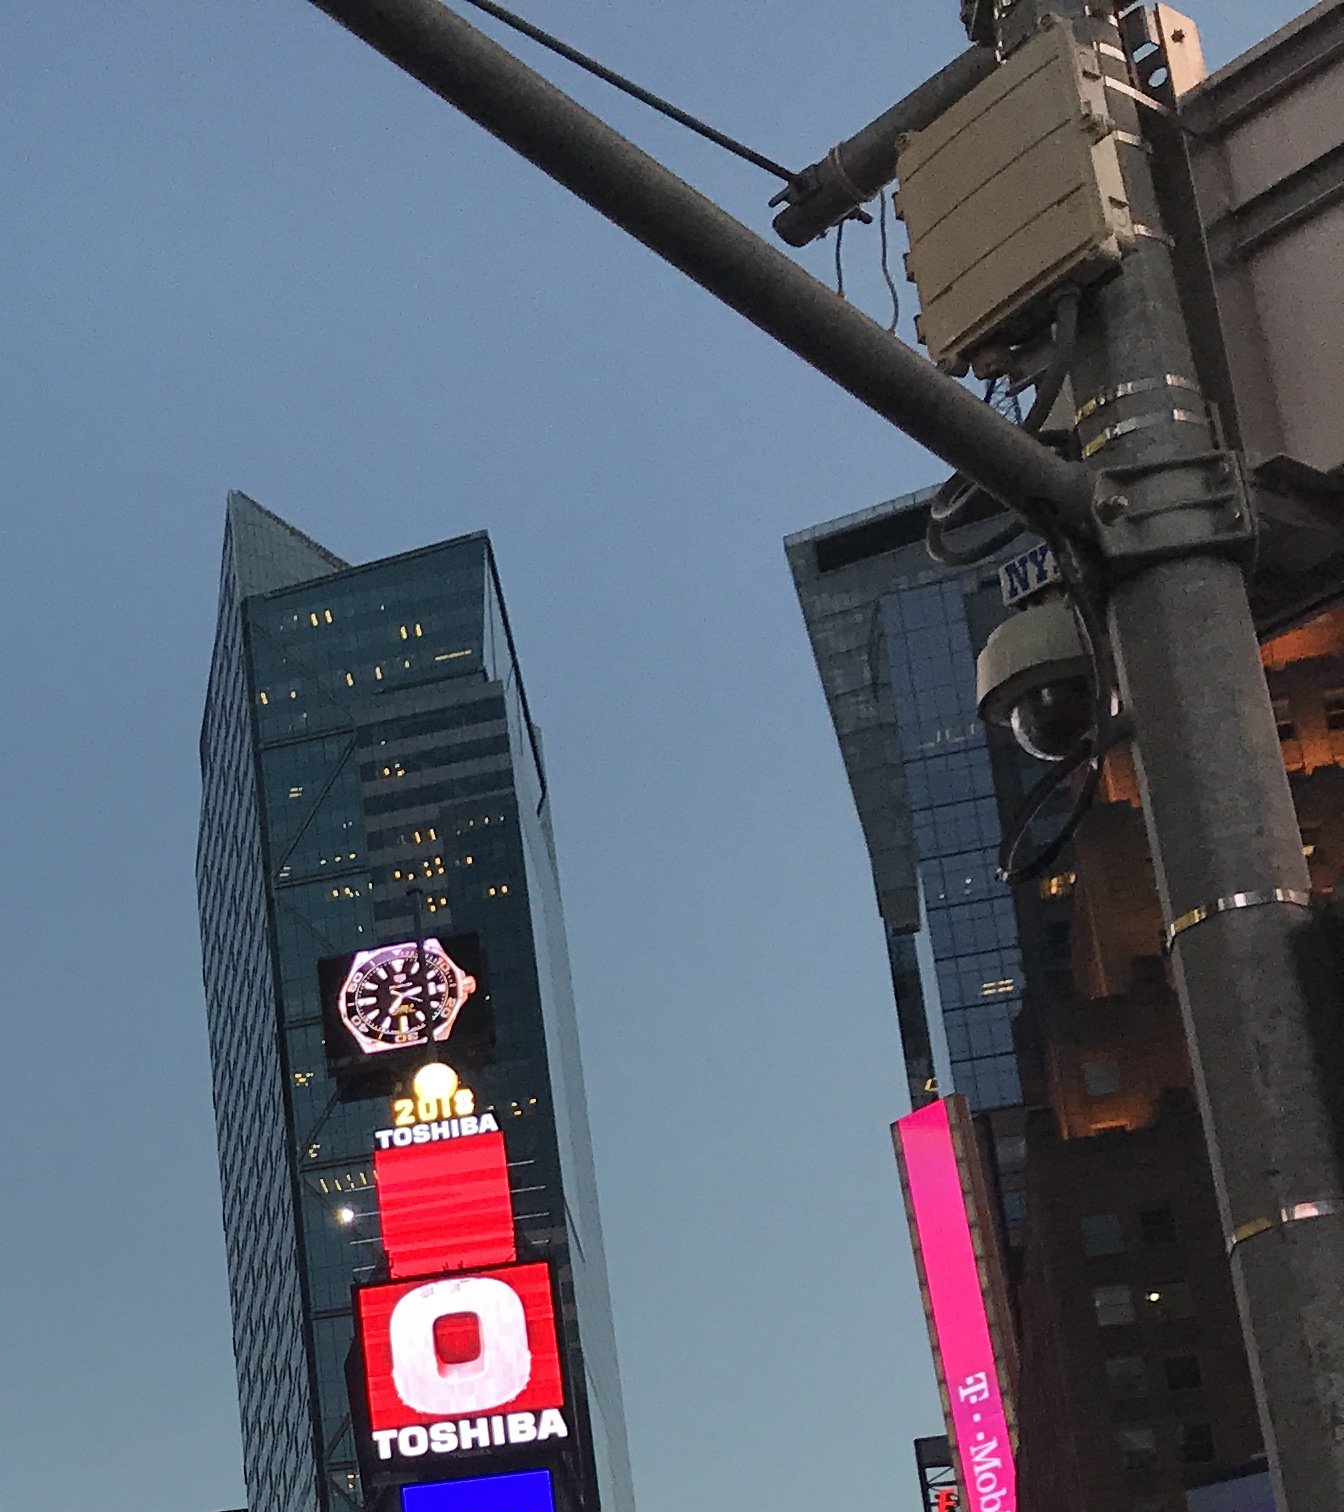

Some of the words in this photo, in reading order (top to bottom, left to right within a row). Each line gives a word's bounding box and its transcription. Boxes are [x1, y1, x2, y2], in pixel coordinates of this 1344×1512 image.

[394, 1088, 475, 1126] 2018
[375, 1113, 499, 1149] TOSHIBA
[372, 1407, 568, 1460] TOSHIBA
